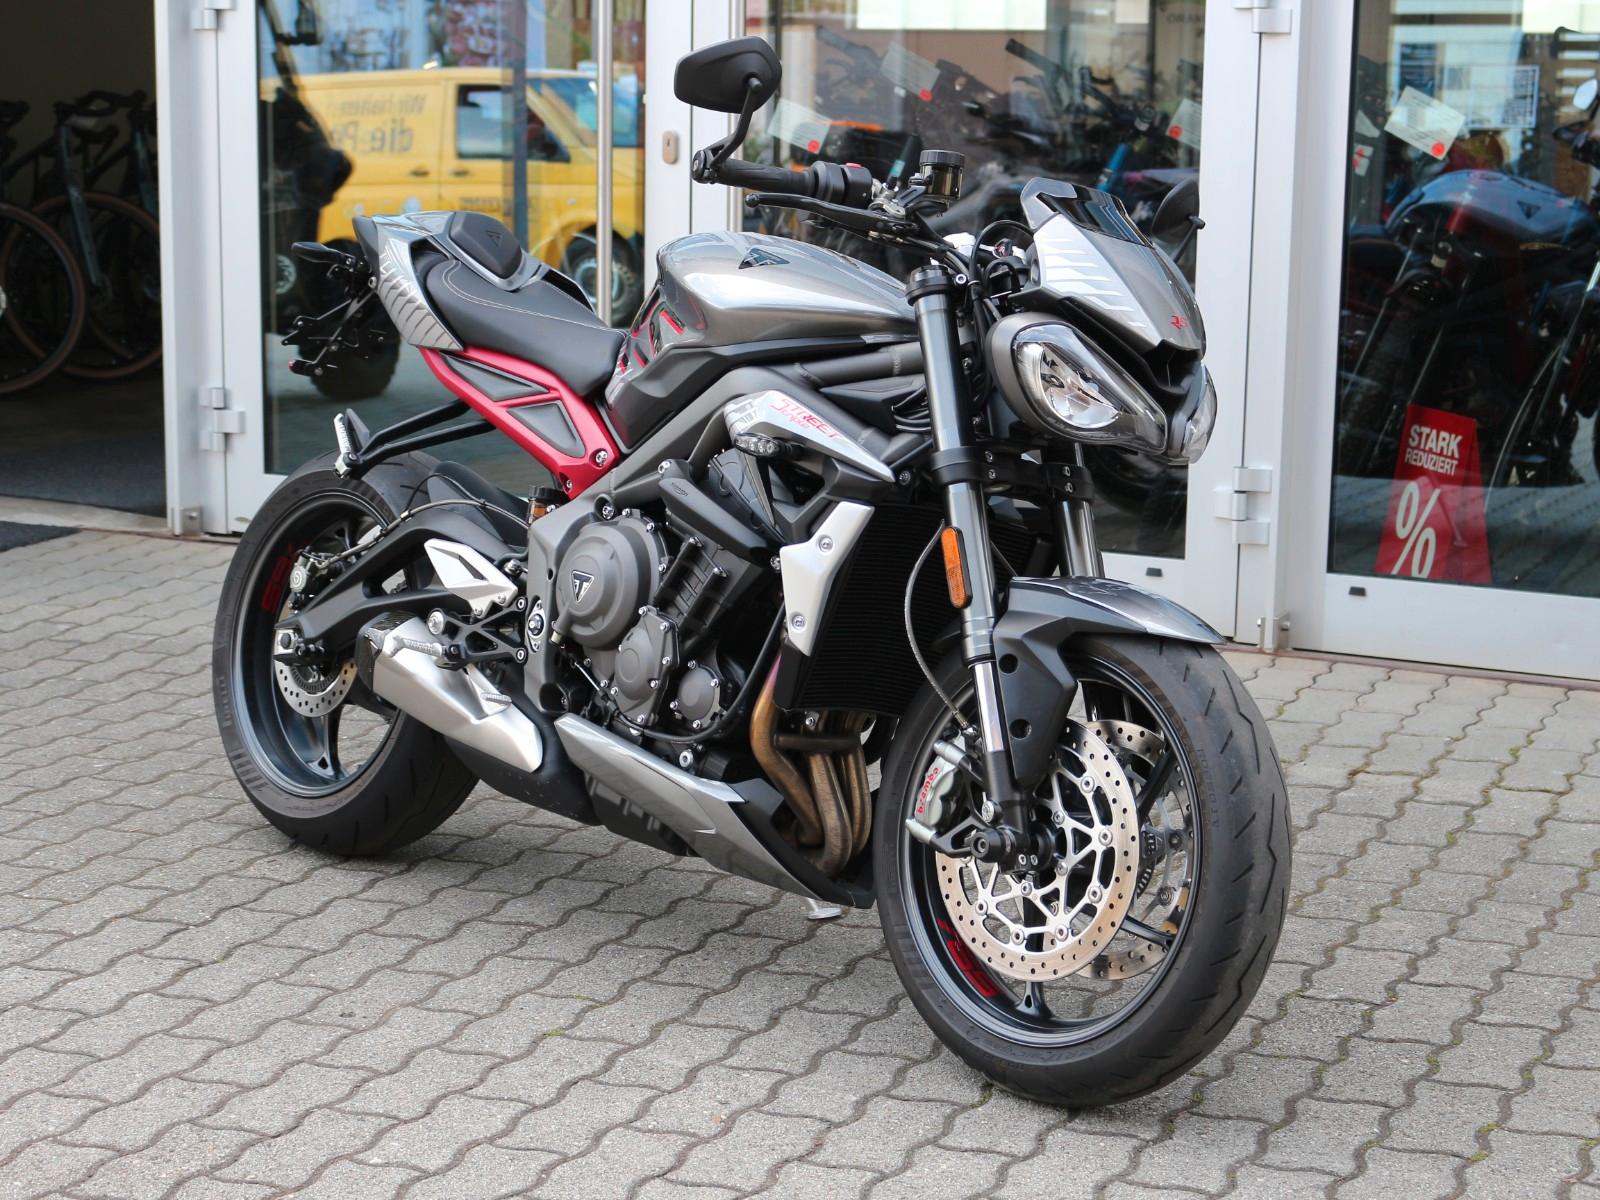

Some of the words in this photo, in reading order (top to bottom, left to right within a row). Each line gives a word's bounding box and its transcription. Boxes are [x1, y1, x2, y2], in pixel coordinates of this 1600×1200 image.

[770, 399, 843, 439] STREET
[1409, 425, 1462, 458] STARK
[1405, 448, 1459, 476] REDUZIERT
[1392, 482, 1440, 578] %
[916, 767, 939, 816] brembo
